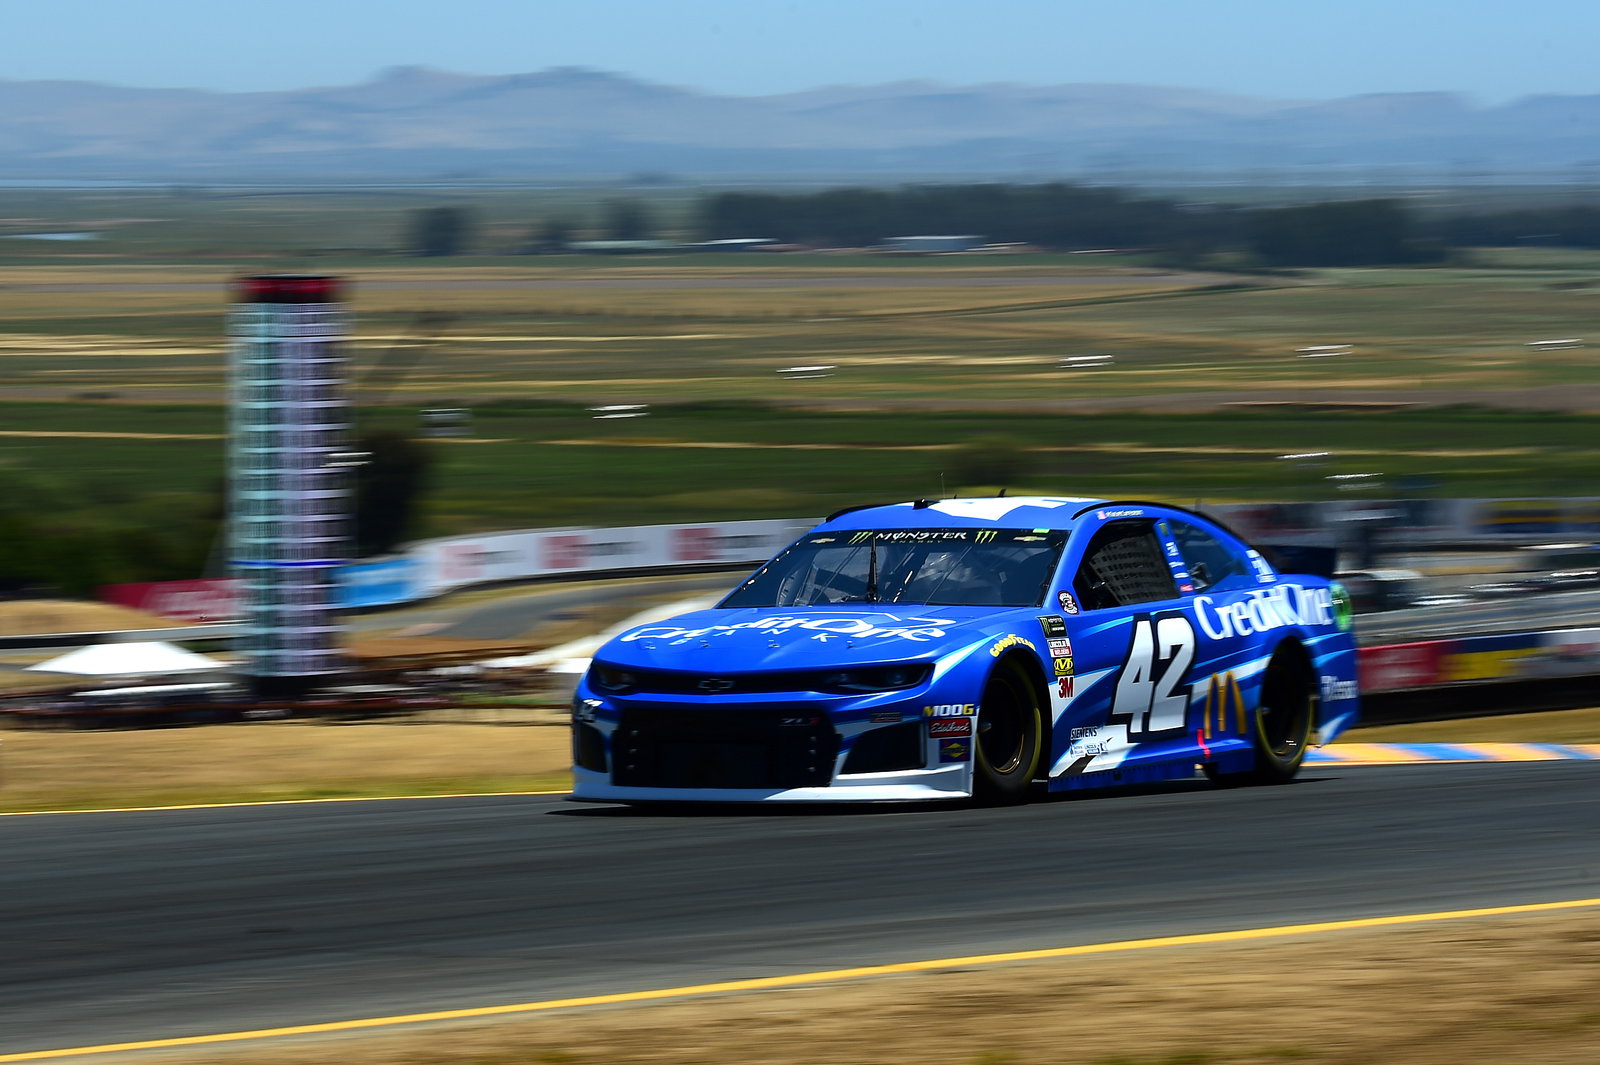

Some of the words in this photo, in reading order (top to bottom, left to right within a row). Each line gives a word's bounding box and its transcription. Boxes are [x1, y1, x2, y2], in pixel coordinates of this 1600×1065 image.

[875, 531, 967, 540] MONSTER
[1112, 617, 1195, 733] 42
[1058, 677, 1074, 699] 3M
[923, 703, 975, 717] MOOG
[1071, 727, 1098, 739] SIEMENS
